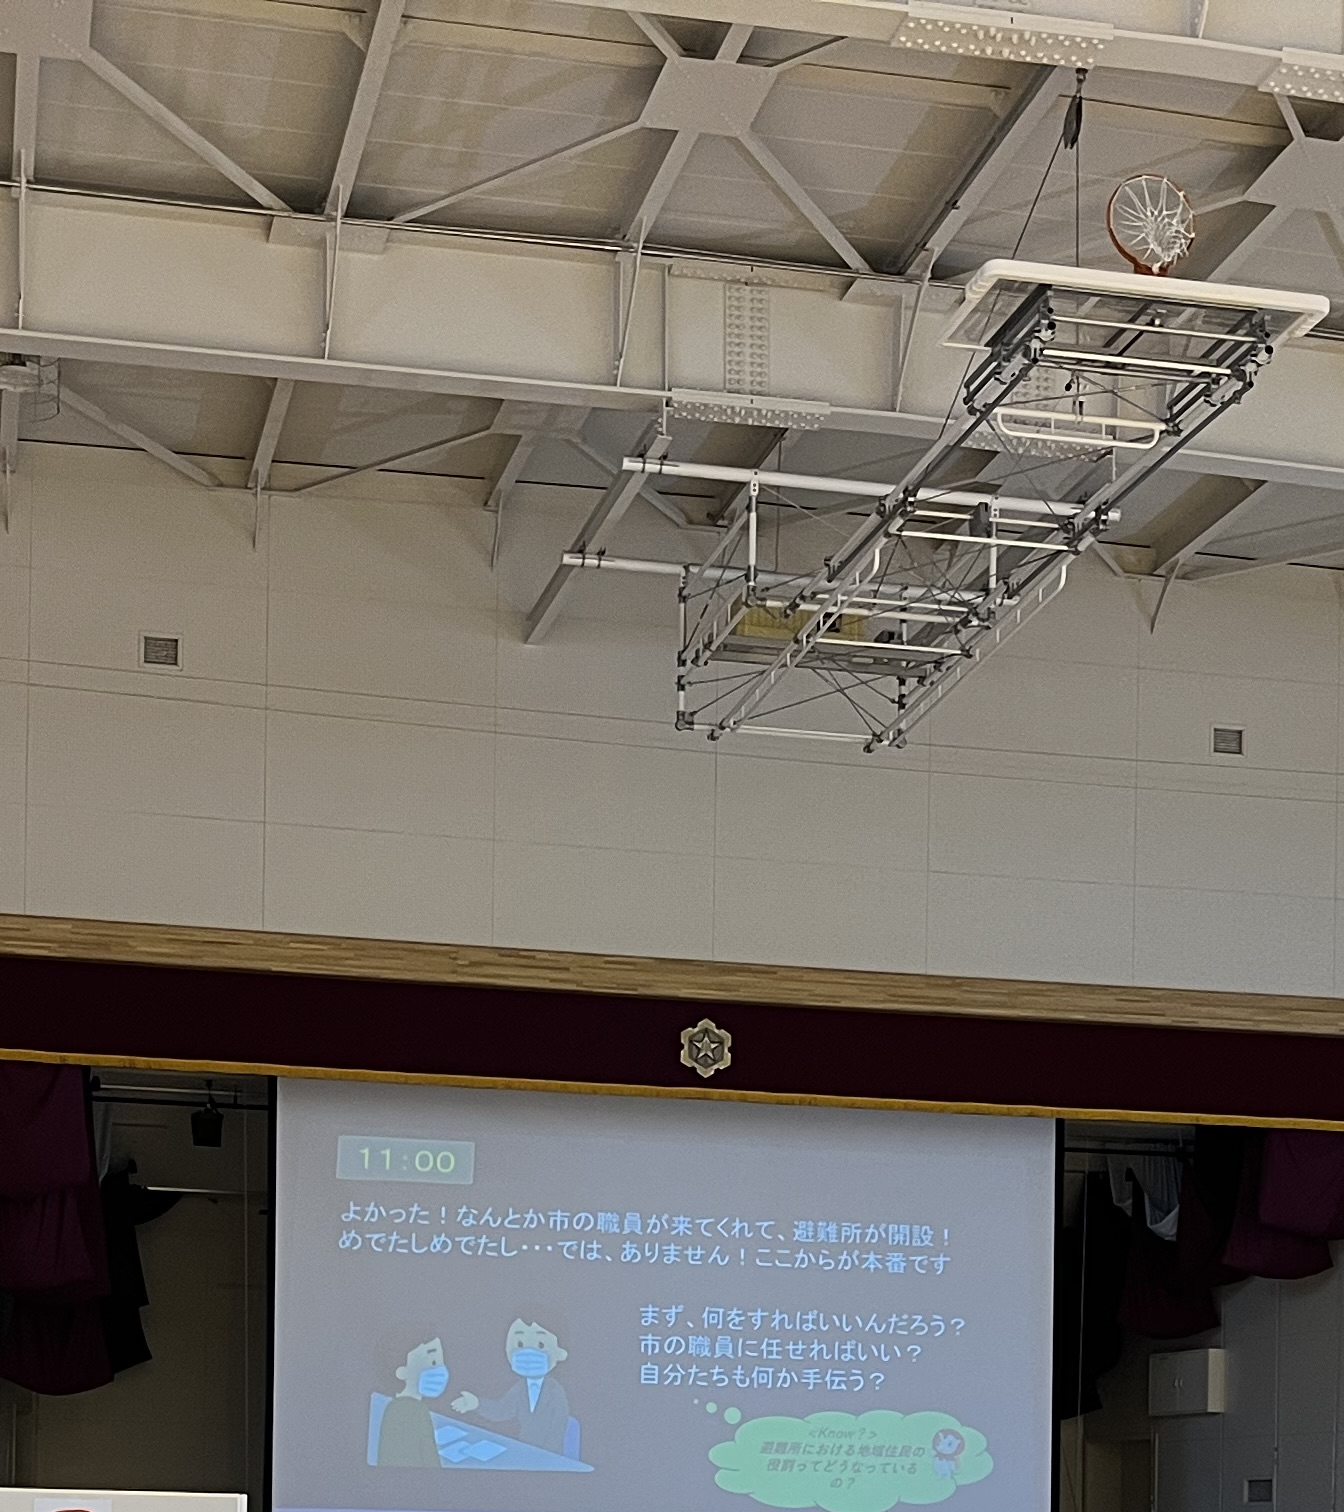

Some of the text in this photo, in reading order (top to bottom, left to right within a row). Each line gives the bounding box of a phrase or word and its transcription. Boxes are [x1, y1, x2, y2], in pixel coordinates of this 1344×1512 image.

[359, 1147, 456, 1173] 11:00
[340, 1201, 950, 1248] よかった！なんとか市の職員が来てくれて、避難所が開設！
[639, 1304, 966, 1337] まず、何をすればいいんだろう？
[639, 1333, 922, 1363] 市の職員に任せればいい？
[640, 1362, 885, 1391] 自分たちも何か手伝う？
[760, 1441, 926, 1458] 避難所における地域住民の
[767, 1458, 918, 1475] 役割ってどうなっている
